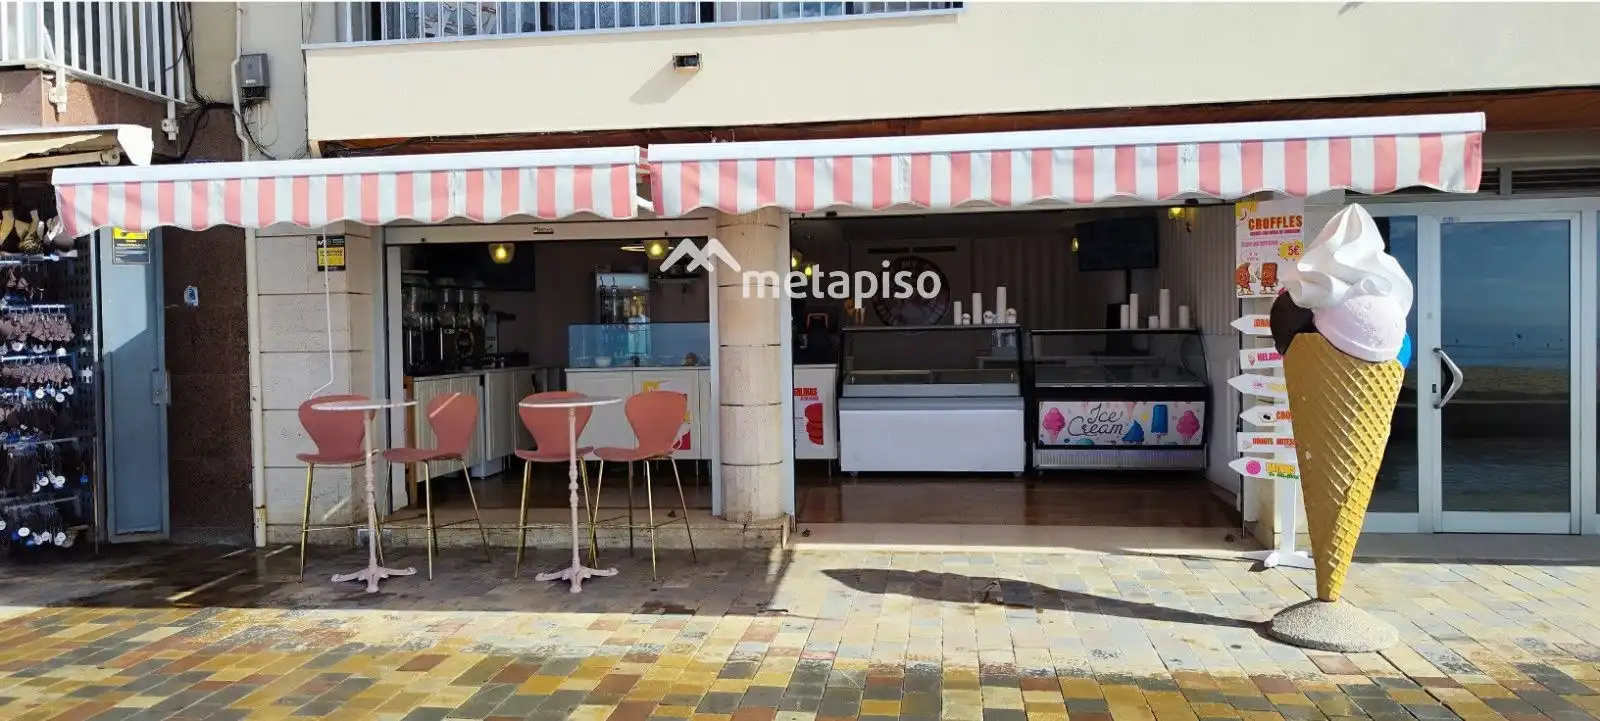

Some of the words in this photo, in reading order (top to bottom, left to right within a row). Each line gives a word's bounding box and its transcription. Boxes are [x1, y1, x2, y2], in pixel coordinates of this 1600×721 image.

[1248, 215, 1302, 230] CROFFLES
[1288, 245, 1300, 256] 5€
[1087, 403, 1123, 424] Ice
[1067, 416, 1123, 437] Cream
